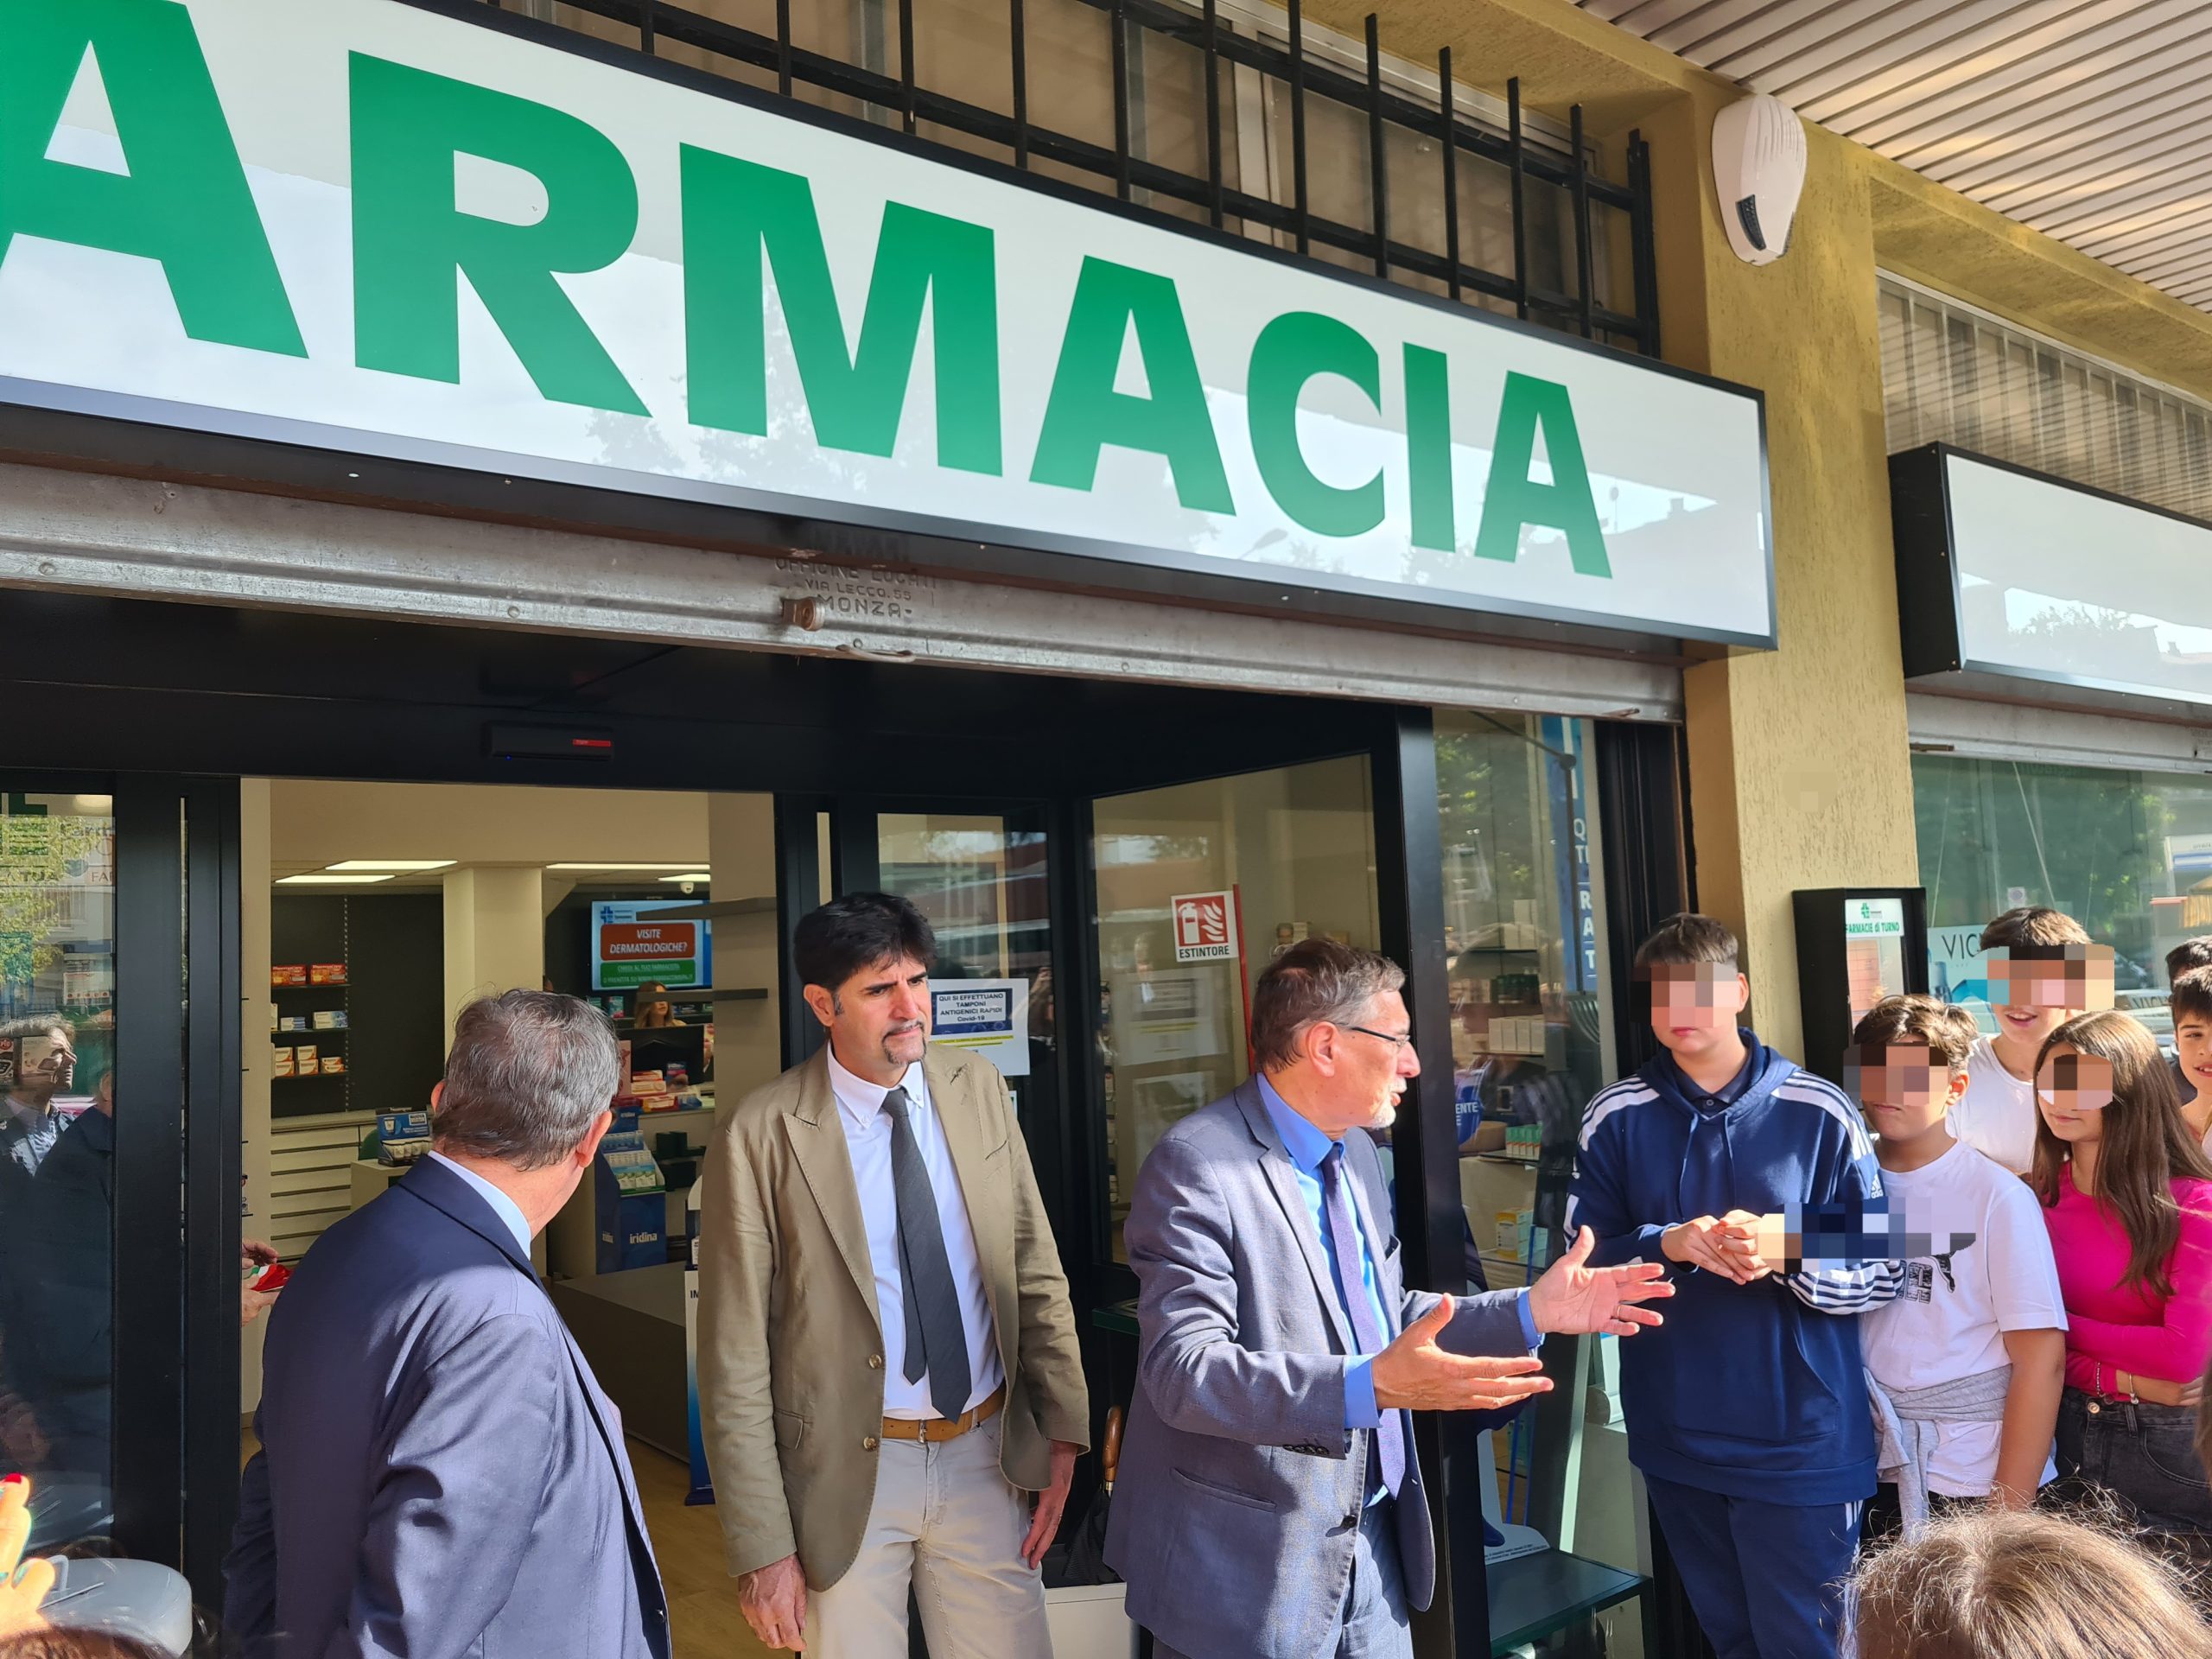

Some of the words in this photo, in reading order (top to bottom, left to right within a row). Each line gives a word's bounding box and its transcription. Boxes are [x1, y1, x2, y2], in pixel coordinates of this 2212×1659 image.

[0, 0, 1612, 579] ARMACIA
[805, 578, 830, 592] VIA
[1881, 921, 1900, 932] TURNO
[636, 929, 661, 938] VISITE
[609, 941, 688, 955] DERMATOLOGICHE?
[1179, 945, 1230, 959] ESTINTORE
[1941, 933, 1983, 959] VIC
[959, 993, 1004, 1001] EFFETTUANO
[957, 1014, 985, 1023] Covid-19
[629, 1231, 658, 1244] iridina
